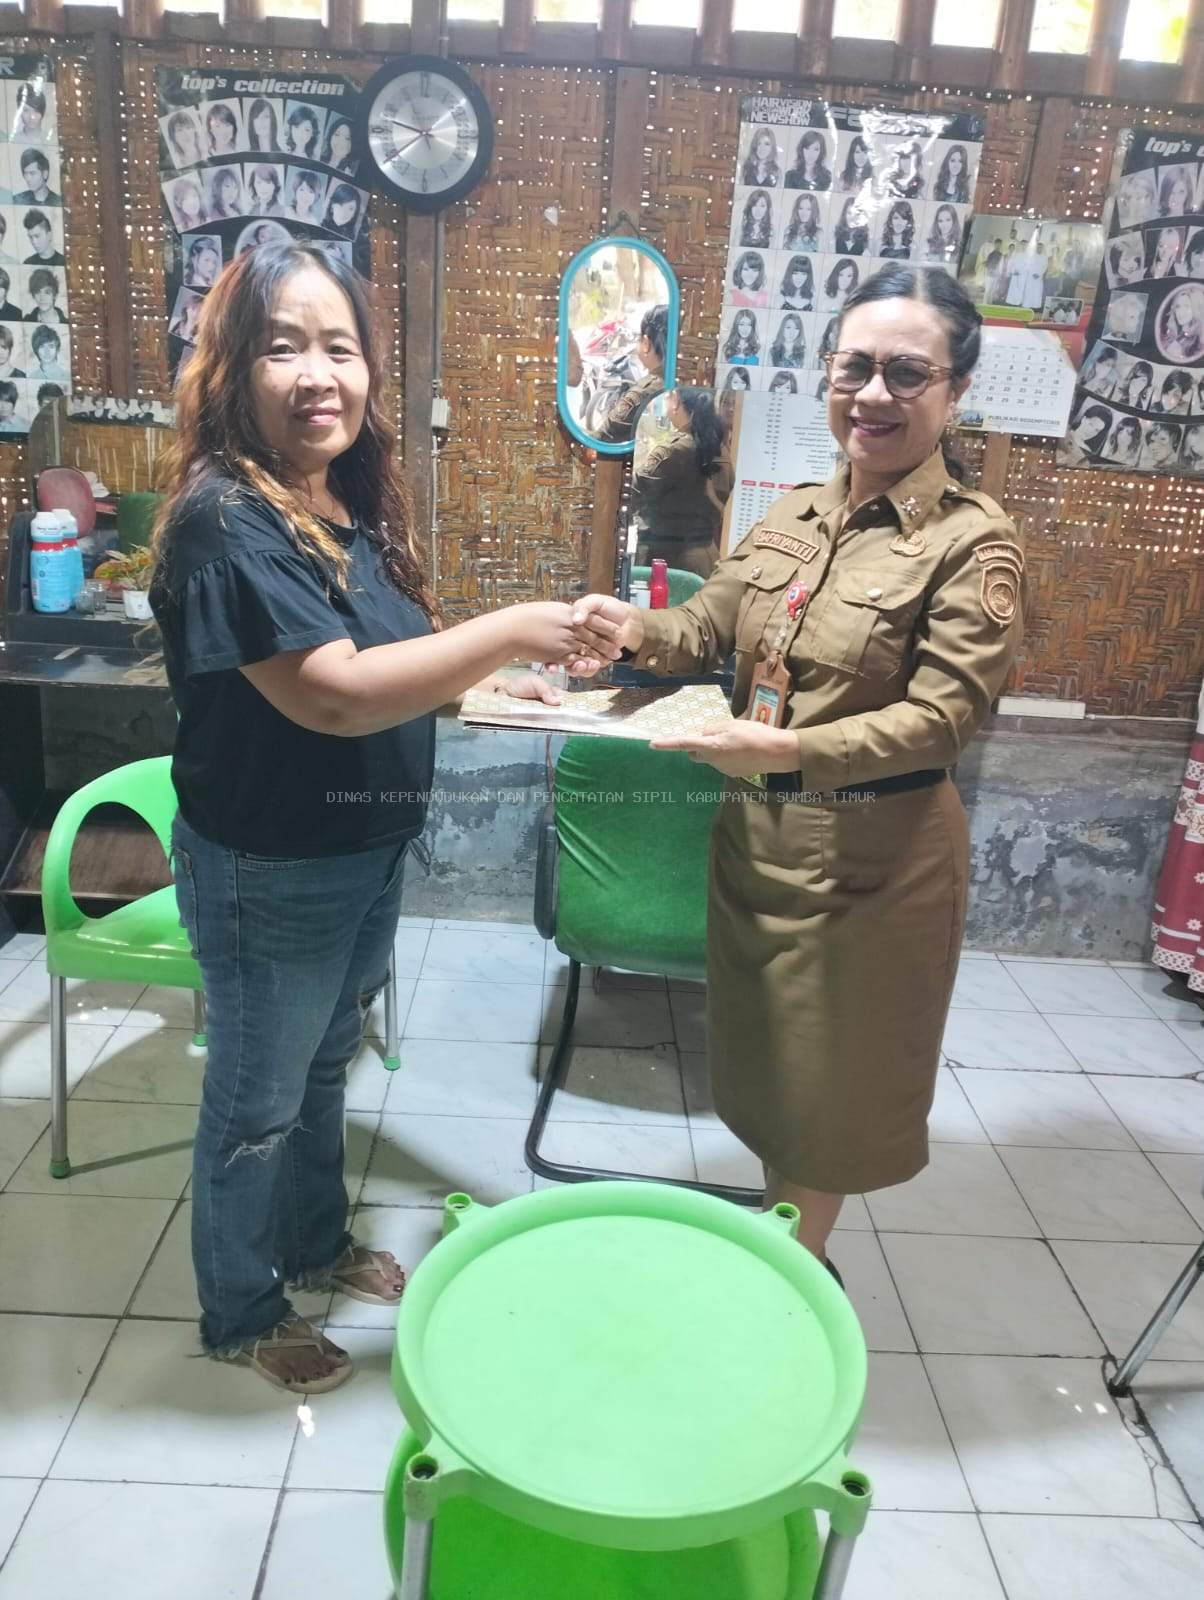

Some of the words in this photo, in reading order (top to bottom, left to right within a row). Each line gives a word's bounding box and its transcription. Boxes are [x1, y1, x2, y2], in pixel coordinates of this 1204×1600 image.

[181, 74, 227, 92] top's
[233, 79, 344, 96] collection
[1144, 136, 1192, 157] top's
